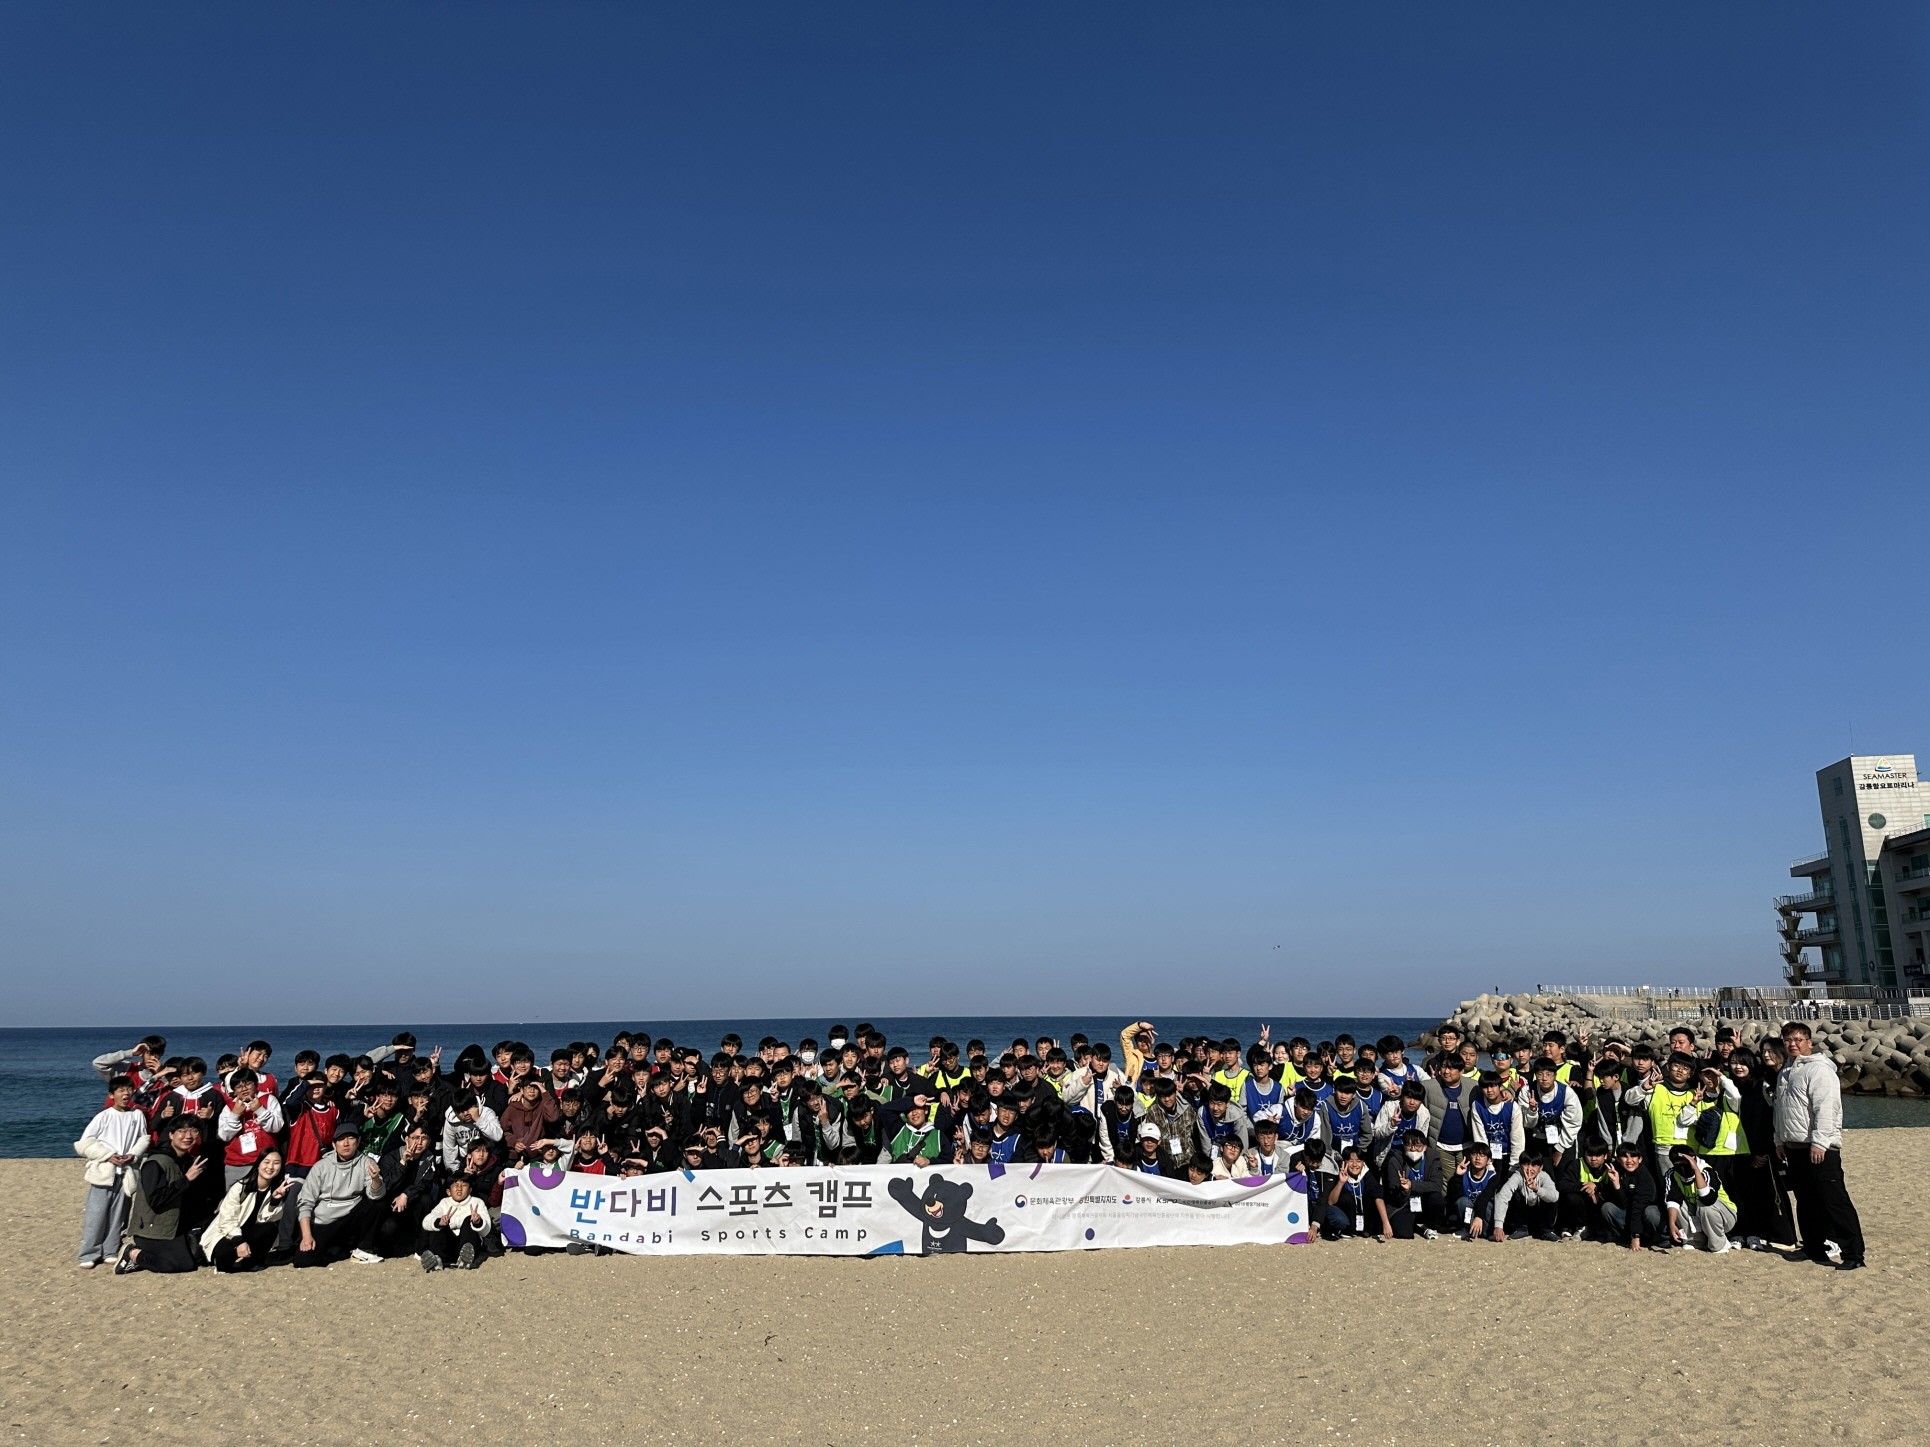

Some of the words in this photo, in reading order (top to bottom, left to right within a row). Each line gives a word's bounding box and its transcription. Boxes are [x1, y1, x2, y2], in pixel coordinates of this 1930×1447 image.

[570, 1187, 677, 1224] 반다비
[697, 1182, 793, 1216] 스포츠
[806, 1180, 872, 1218] 캠프
[570, 1229, 672, 1244] Bandabi
[701, 1228, 786, 1242] Sports
[804, 1227, 867, 1242] Camp
